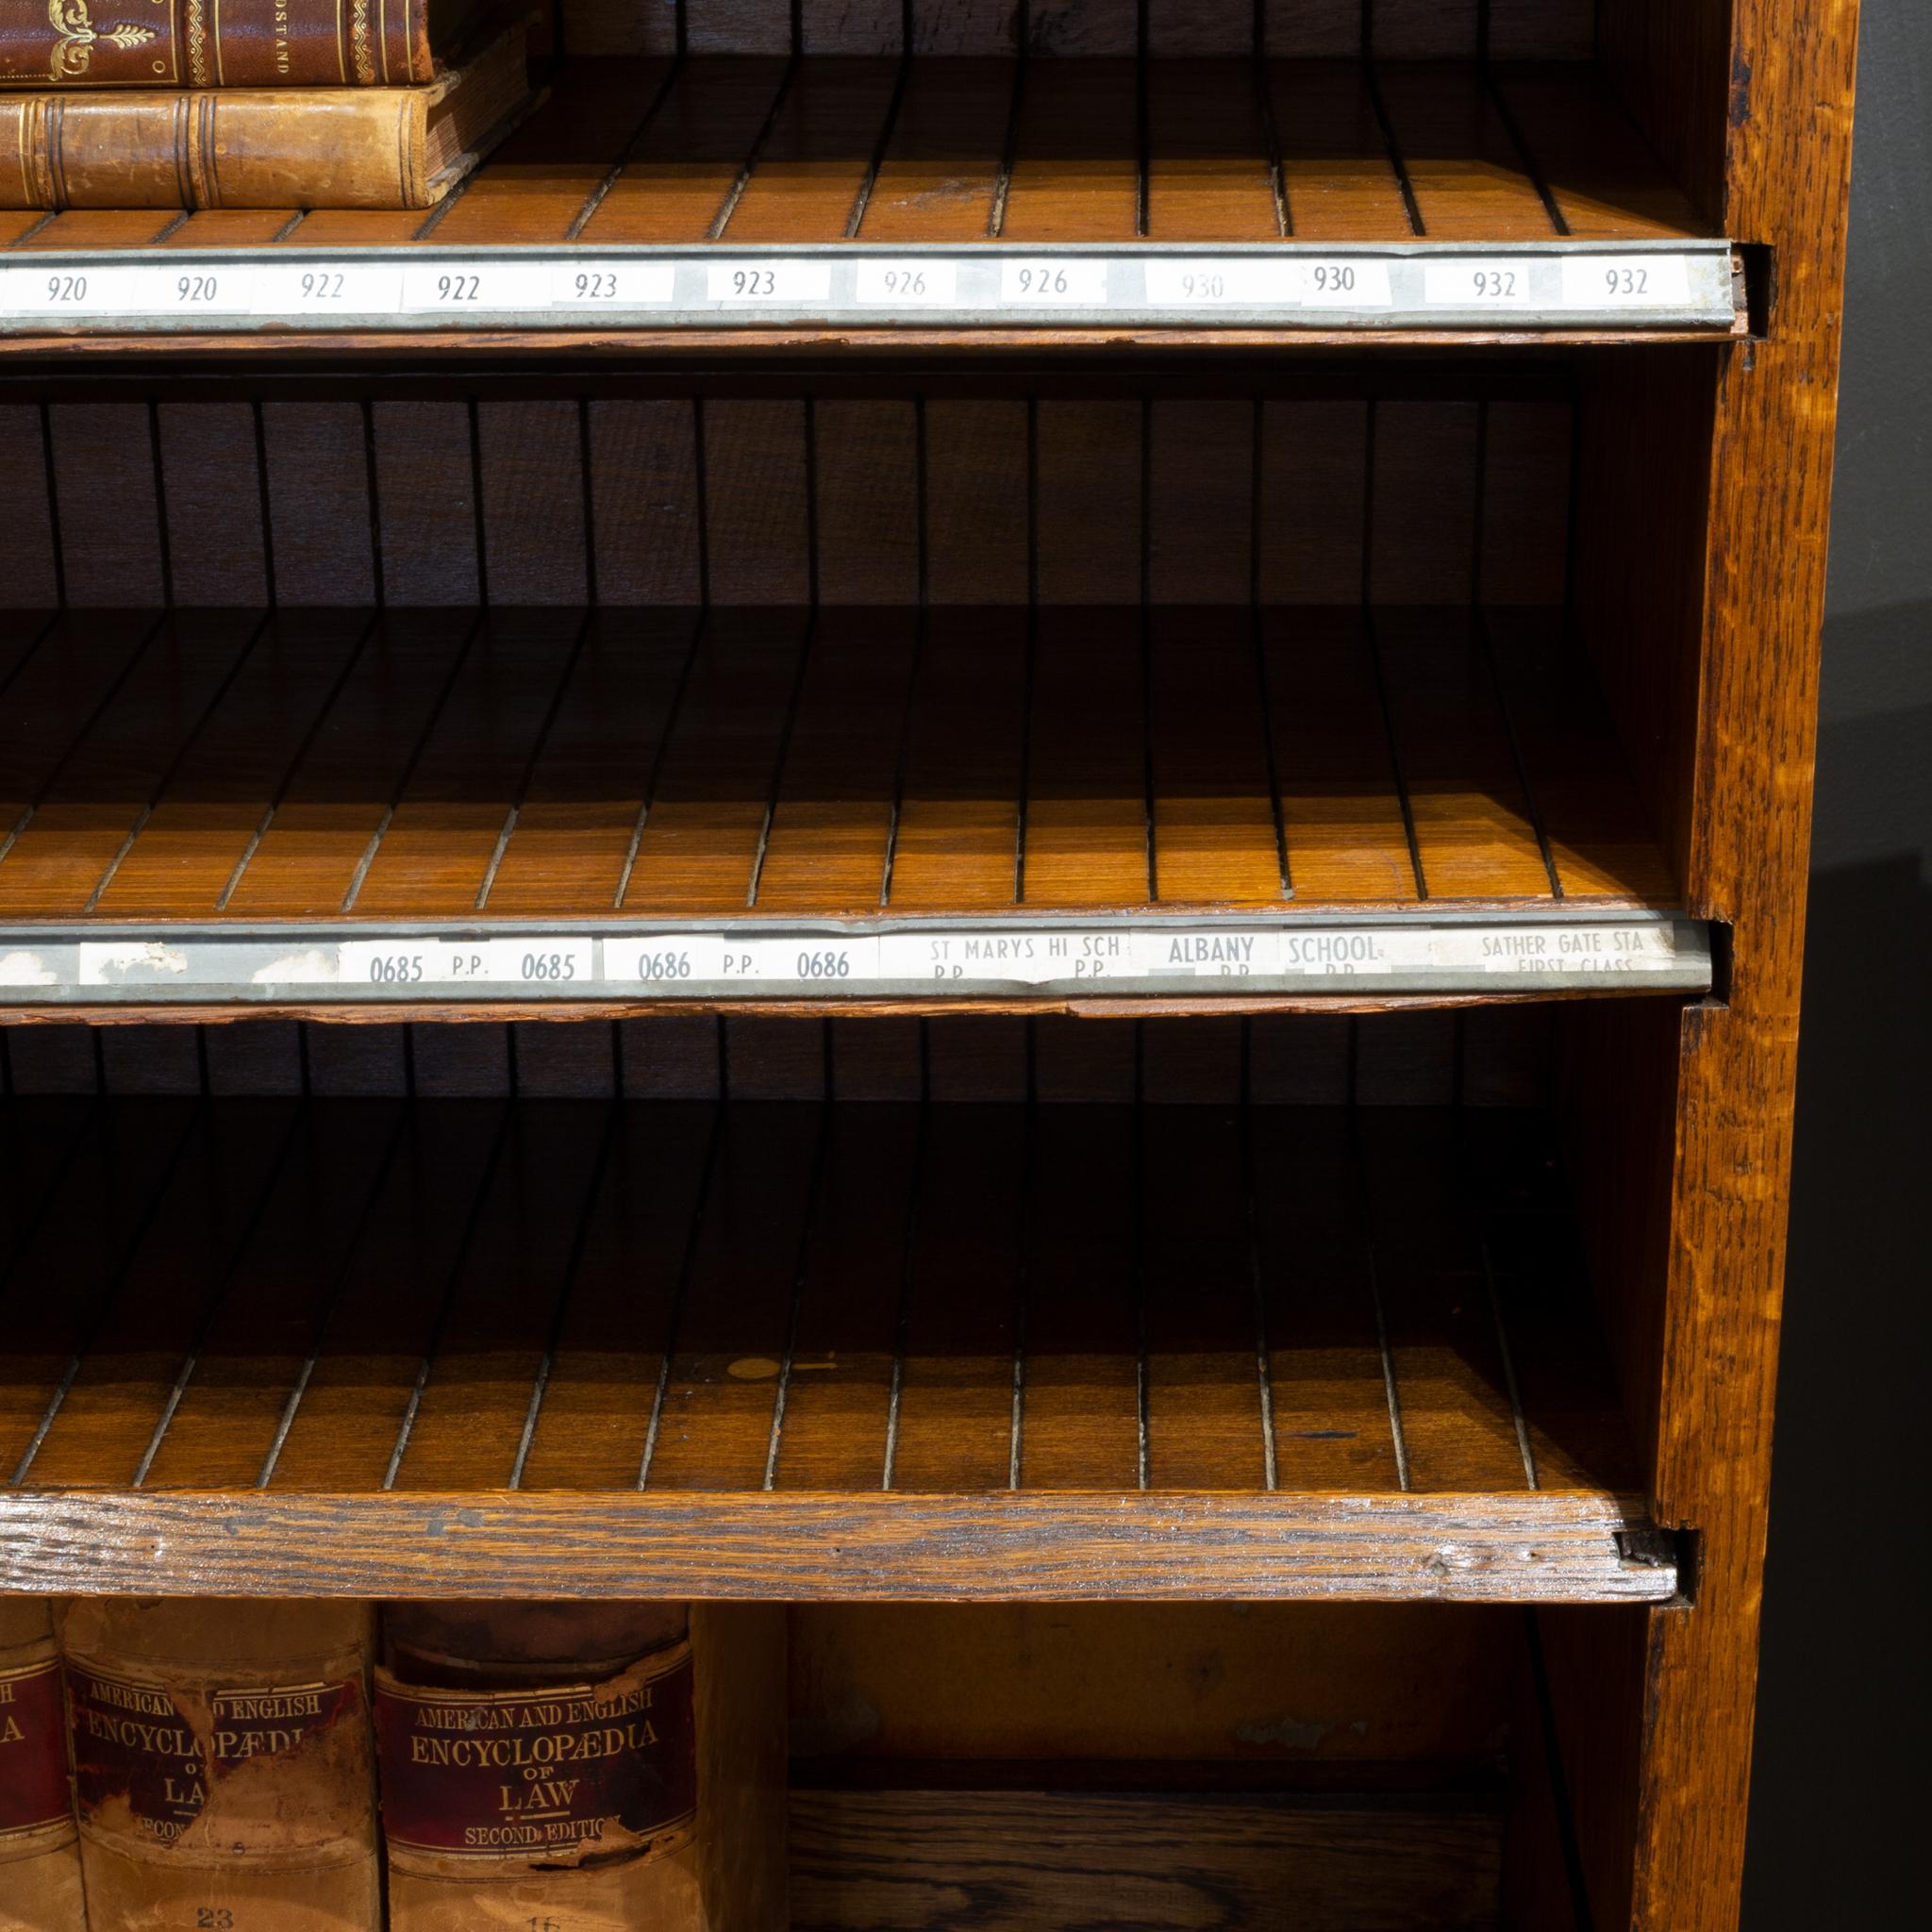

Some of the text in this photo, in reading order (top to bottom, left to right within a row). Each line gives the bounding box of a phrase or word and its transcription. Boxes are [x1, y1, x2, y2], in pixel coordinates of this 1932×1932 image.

[48, 276, 87, 301] 920
[178, 276, 217, 301] 920
[302, 274, 343, 297] 922
[439, 275, 479, 300] 922
[575, 274, 617, 297] 923
[733, 271, 774, 294] 923
[885, 272, 925, 295] 926
[1019, 269, 1067, 293] 926
[1183, 275, 1224, 297] 930
[1314, 267, 1355, 291] 930
[1474, 272, 1515, 296] 932
[1606, 269, 1647, 294] 932
[931, 936, 1119, 960] ST MARYS HI SCH
[1169, 937, 1254, 963] ALBANY
[1482, 931, 1643, 957] SATHER GATE STA
[370, 954, 575, 982] 0685 P.P. 0685
[639, 952, 849, 978] 0686 P.P. 0686
[91, 1682, 175, 1717] AMERICAN
[231, 1695, 322, 1720] ENGLISH
[519, 1702, 562, 1728] AND
[411, 1720, 658, 1767] ENCYCLOPÆDIA
[524, 1766, 554, 1780] OF
[499, 1779, 580, 1811] LAW
[465, 1825, 537, 1845] SECOND
[196, 1907, 235, 1930] 23
